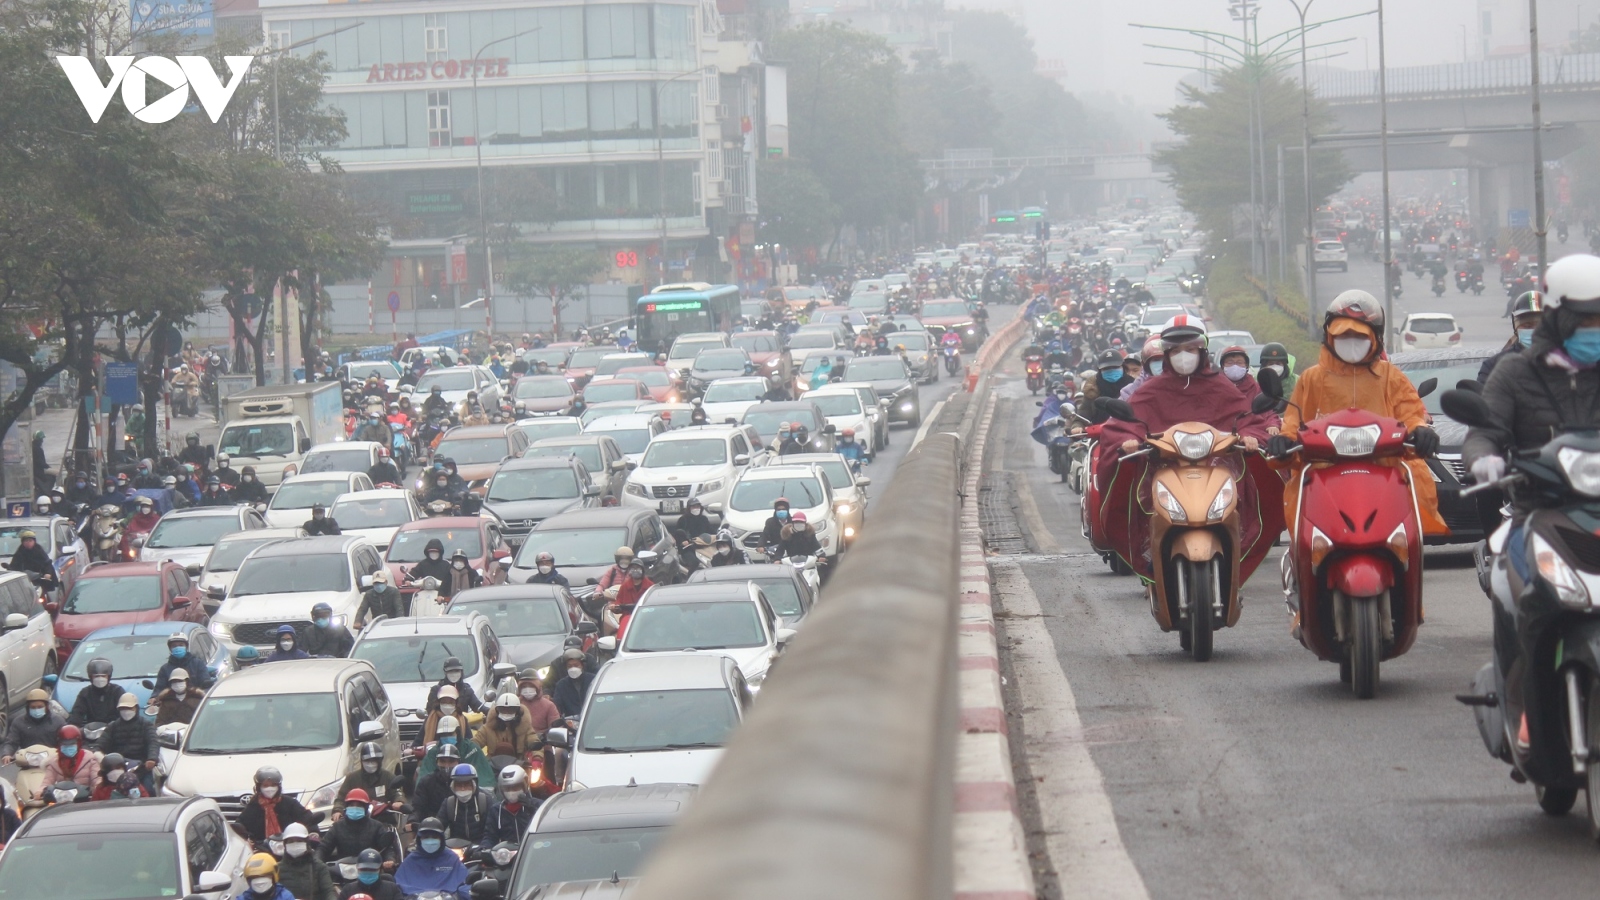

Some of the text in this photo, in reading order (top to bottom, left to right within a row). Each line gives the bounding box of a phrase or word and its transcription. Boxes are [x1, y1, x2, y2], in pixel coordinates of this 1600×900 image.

[366, 57, 510, 83] ARIES COFFEE
[410, 203, 463, 213] Entertainment
[615, 250, 638, 268] 93
